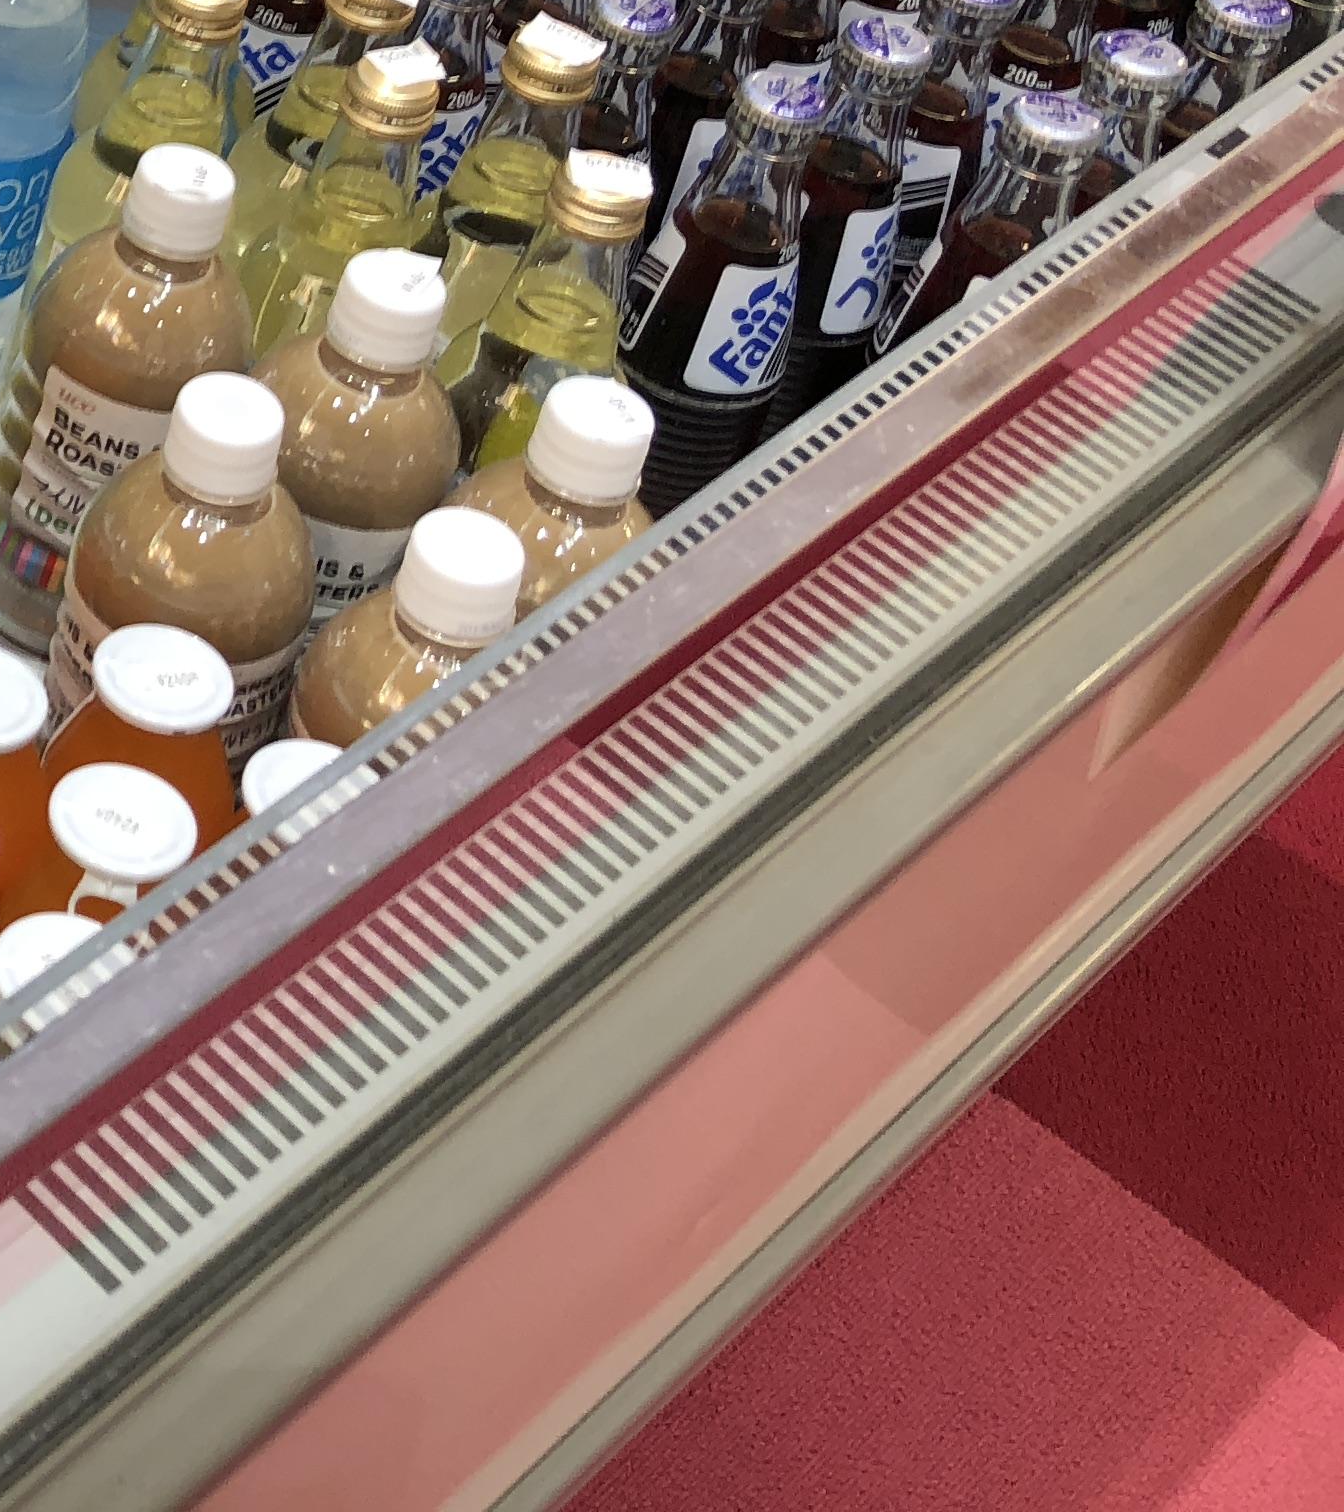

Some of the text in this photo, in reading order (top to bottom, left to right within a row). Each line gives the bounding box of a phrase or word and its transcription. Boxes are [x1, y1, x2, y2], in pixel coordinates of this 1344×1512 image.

[252, 4, 298, 34] 200ml
[1003, 64, 1053, 90] 200ml
[45, 427, 122, 477] ROAS
[54, 406, 140, 460] BEANS
